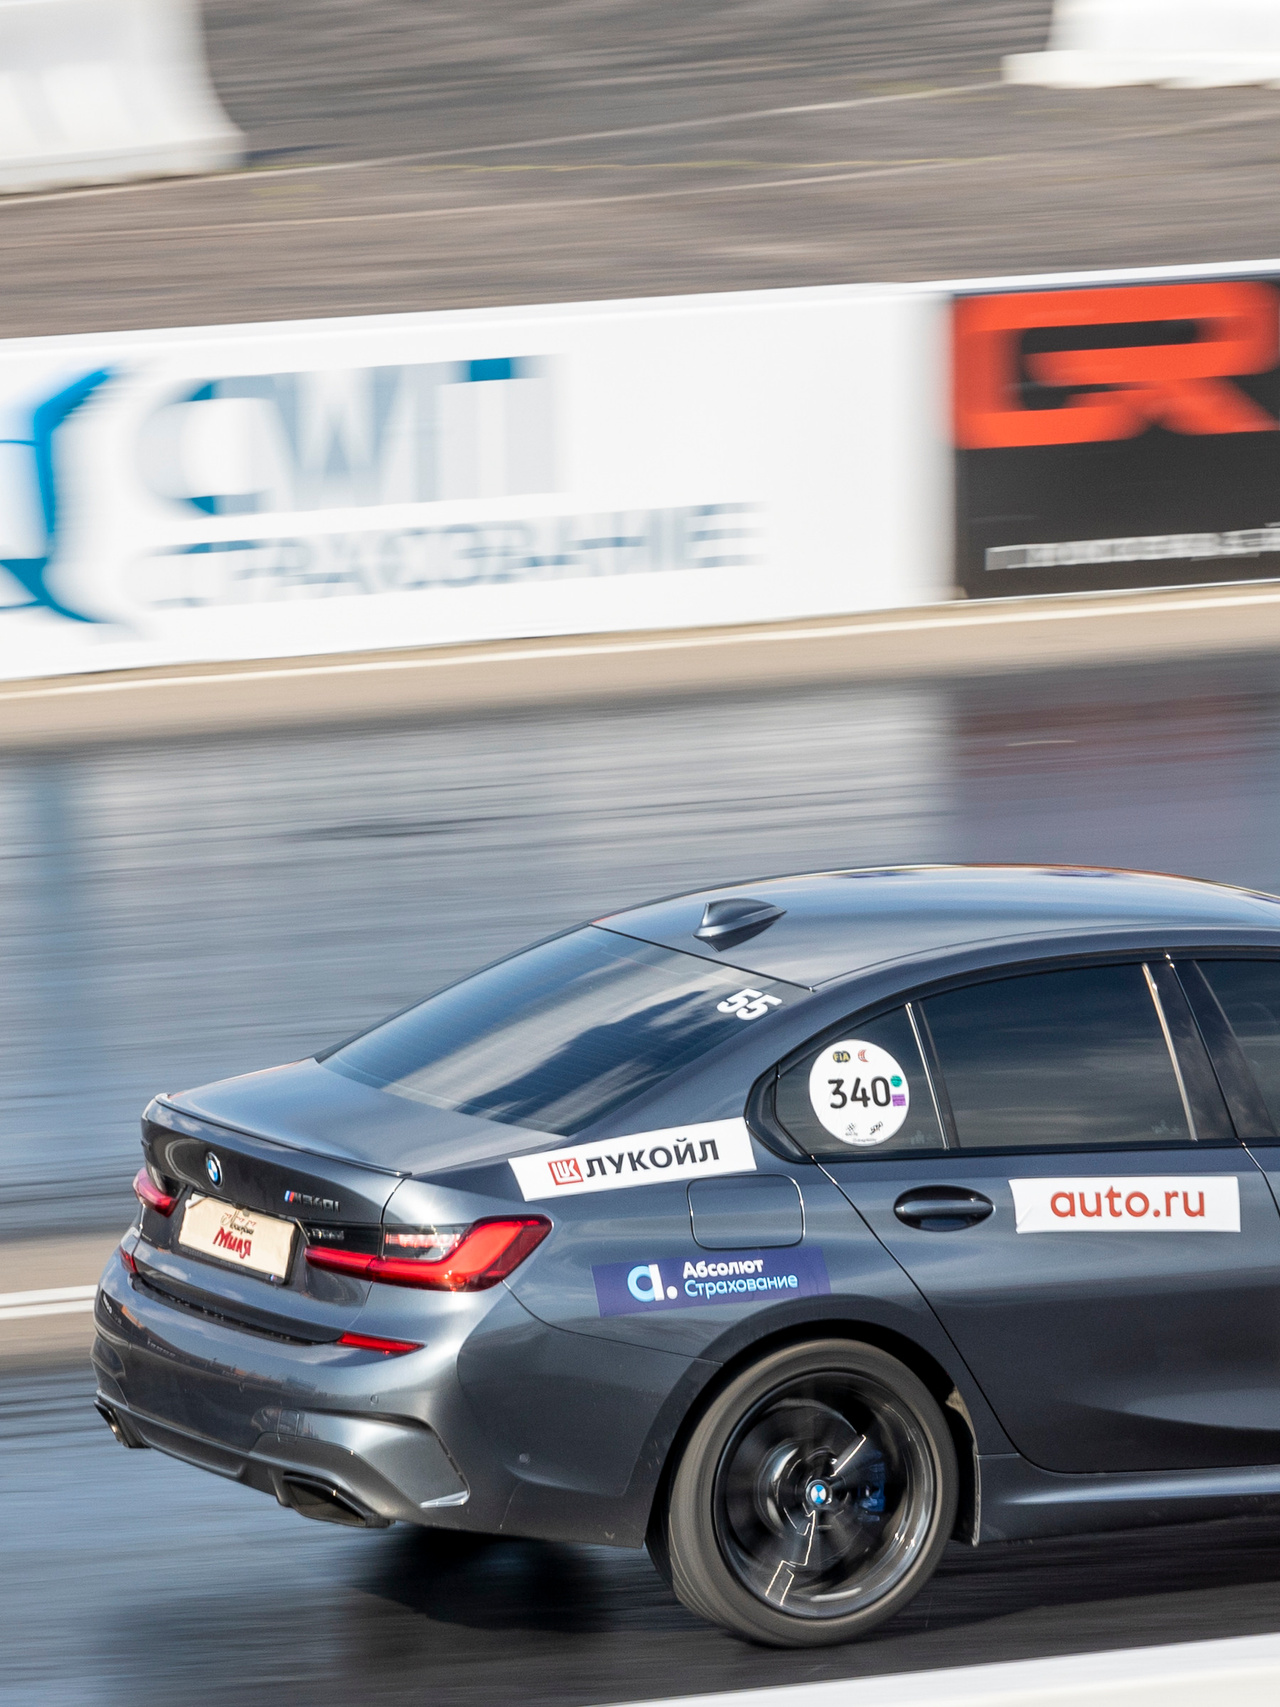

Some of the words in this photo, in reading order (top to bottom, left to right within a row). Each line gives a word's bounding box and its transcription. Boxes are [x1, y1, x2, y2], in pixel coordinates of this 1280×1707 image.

[716, 988, 783, 1021] 55
[828, 1076, 891, 1109] 340
[586, 1137, 720, 1178] ЛУКОЙЛ
[1050, 1185, 1205, 1218] auto.ru
[682, 1259, 764, 1280] Абсолют
[684, 1273, 799, 1299] Страхование
